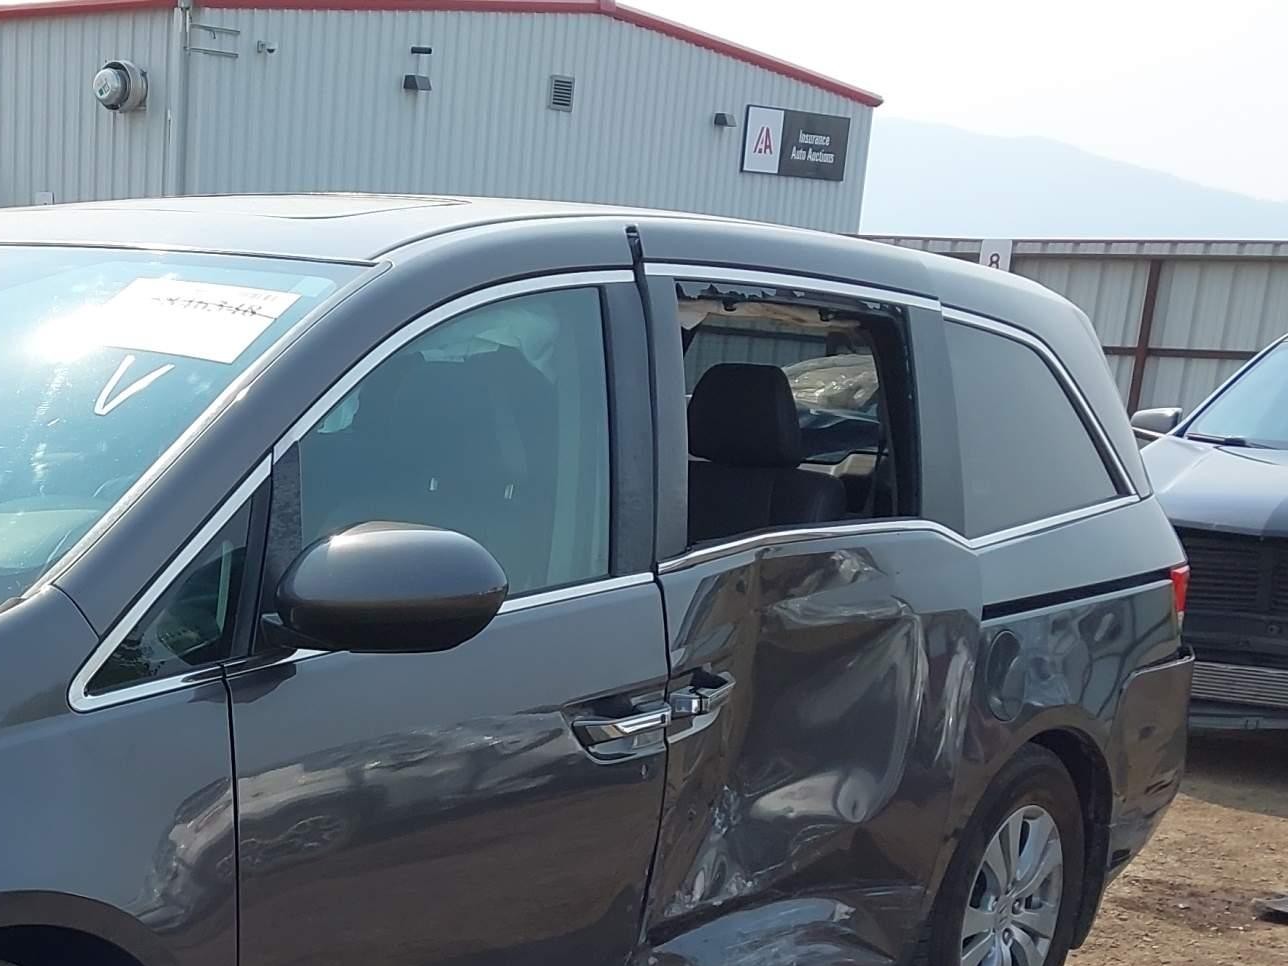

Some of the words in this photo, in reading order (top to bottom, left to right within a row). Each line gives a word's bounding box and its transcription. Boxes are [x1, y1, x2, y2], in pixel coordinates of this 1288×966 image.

[799, 130, 830, 146] Insurance
[790, 146, 807, 161] Auto
[807, 147, 835, 164] Auctions
